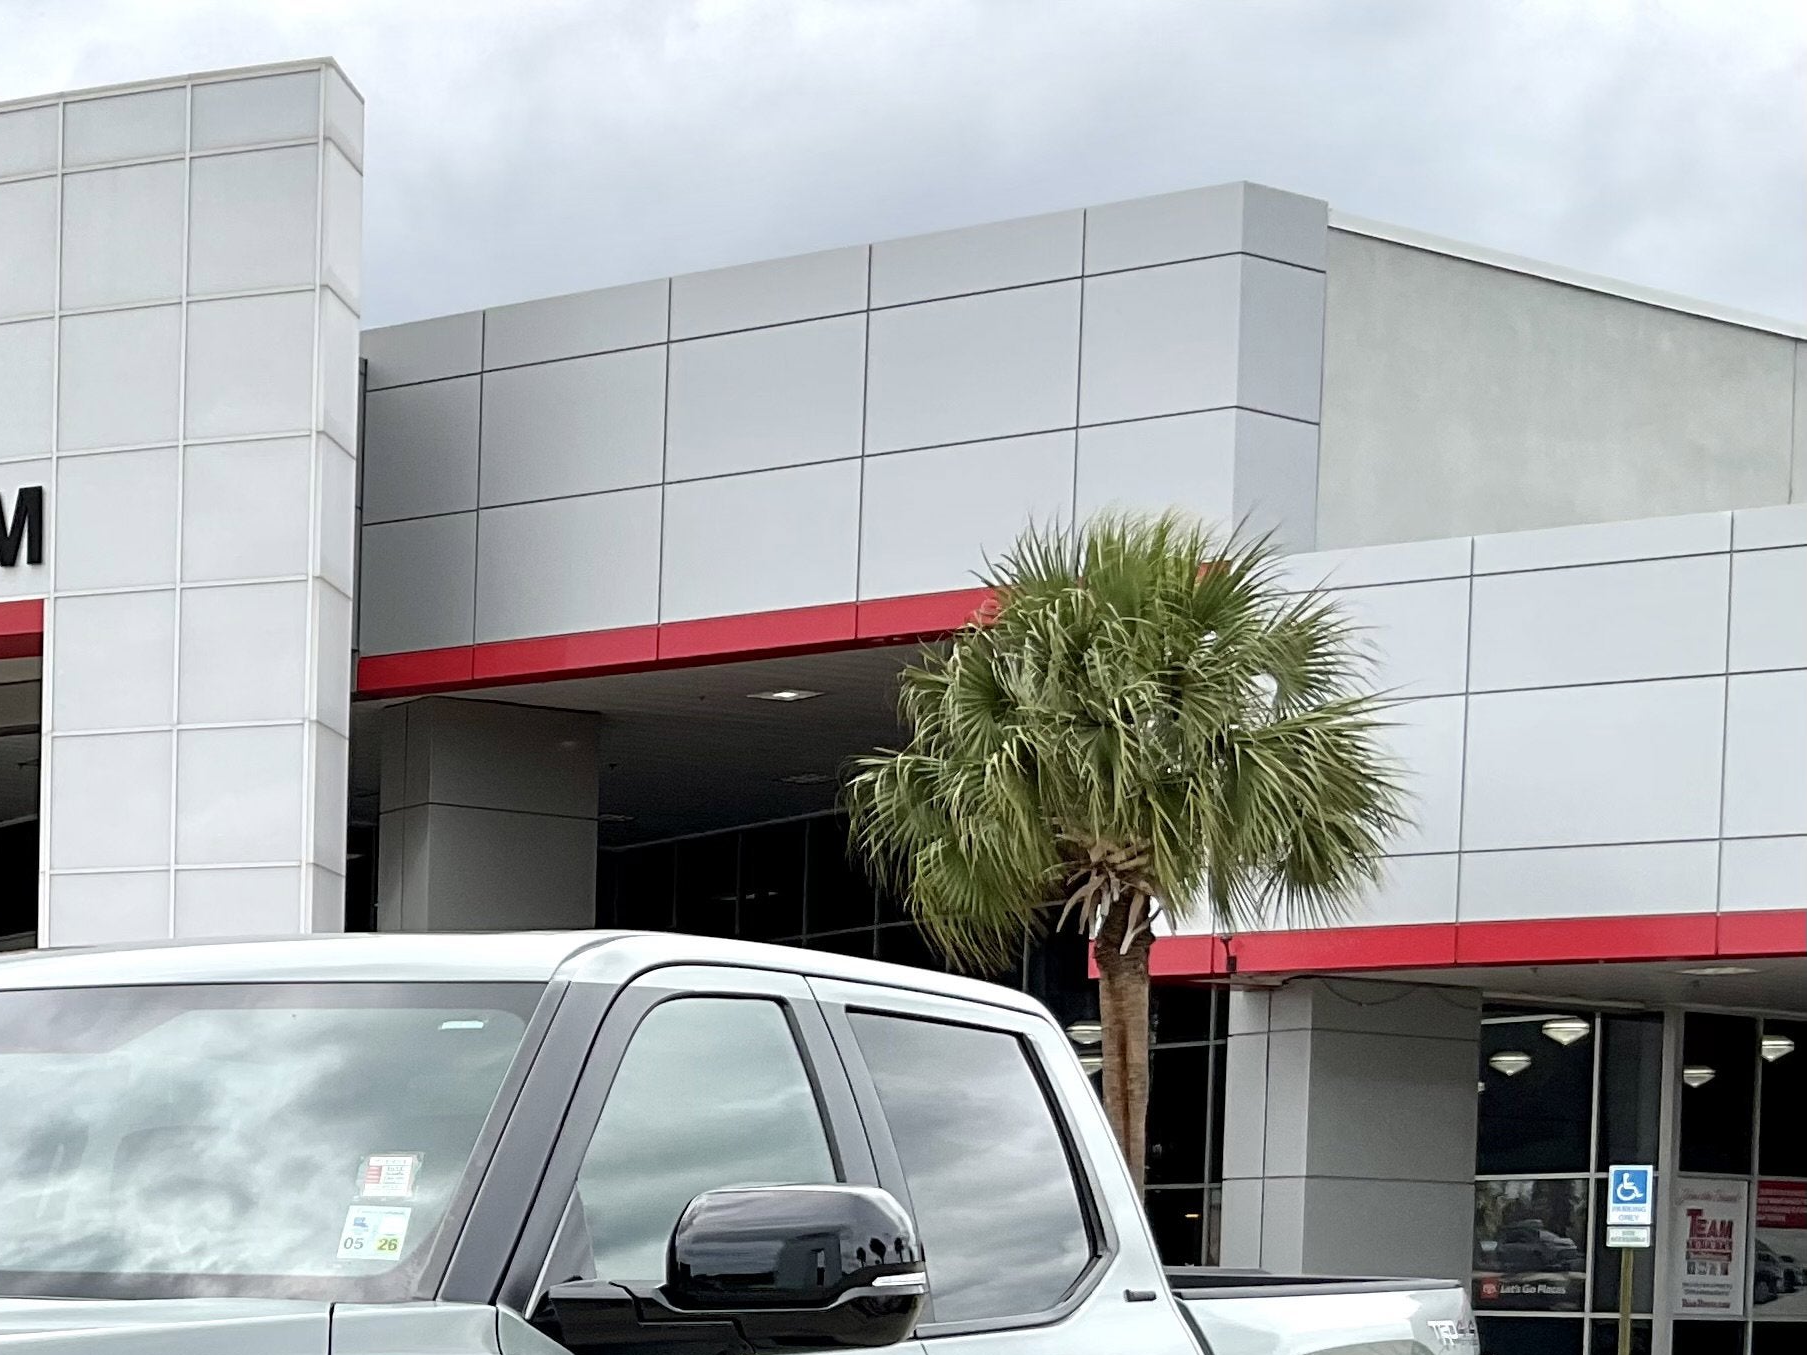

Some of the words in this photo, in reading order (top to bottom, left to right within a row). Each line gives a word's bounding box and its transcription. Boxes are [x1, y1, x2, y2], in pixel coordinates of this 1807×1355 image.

[343, 1237, 364, 1250] 05
[377, 1238, 398, 1251] 26
[1500, 1284, 1521, 1294] Let's
[1522, 1284, 1537, 1294] Go
[1537, 1284, 1567, 1295] Places
[1427, 1320, 1459, 1346] TRD
